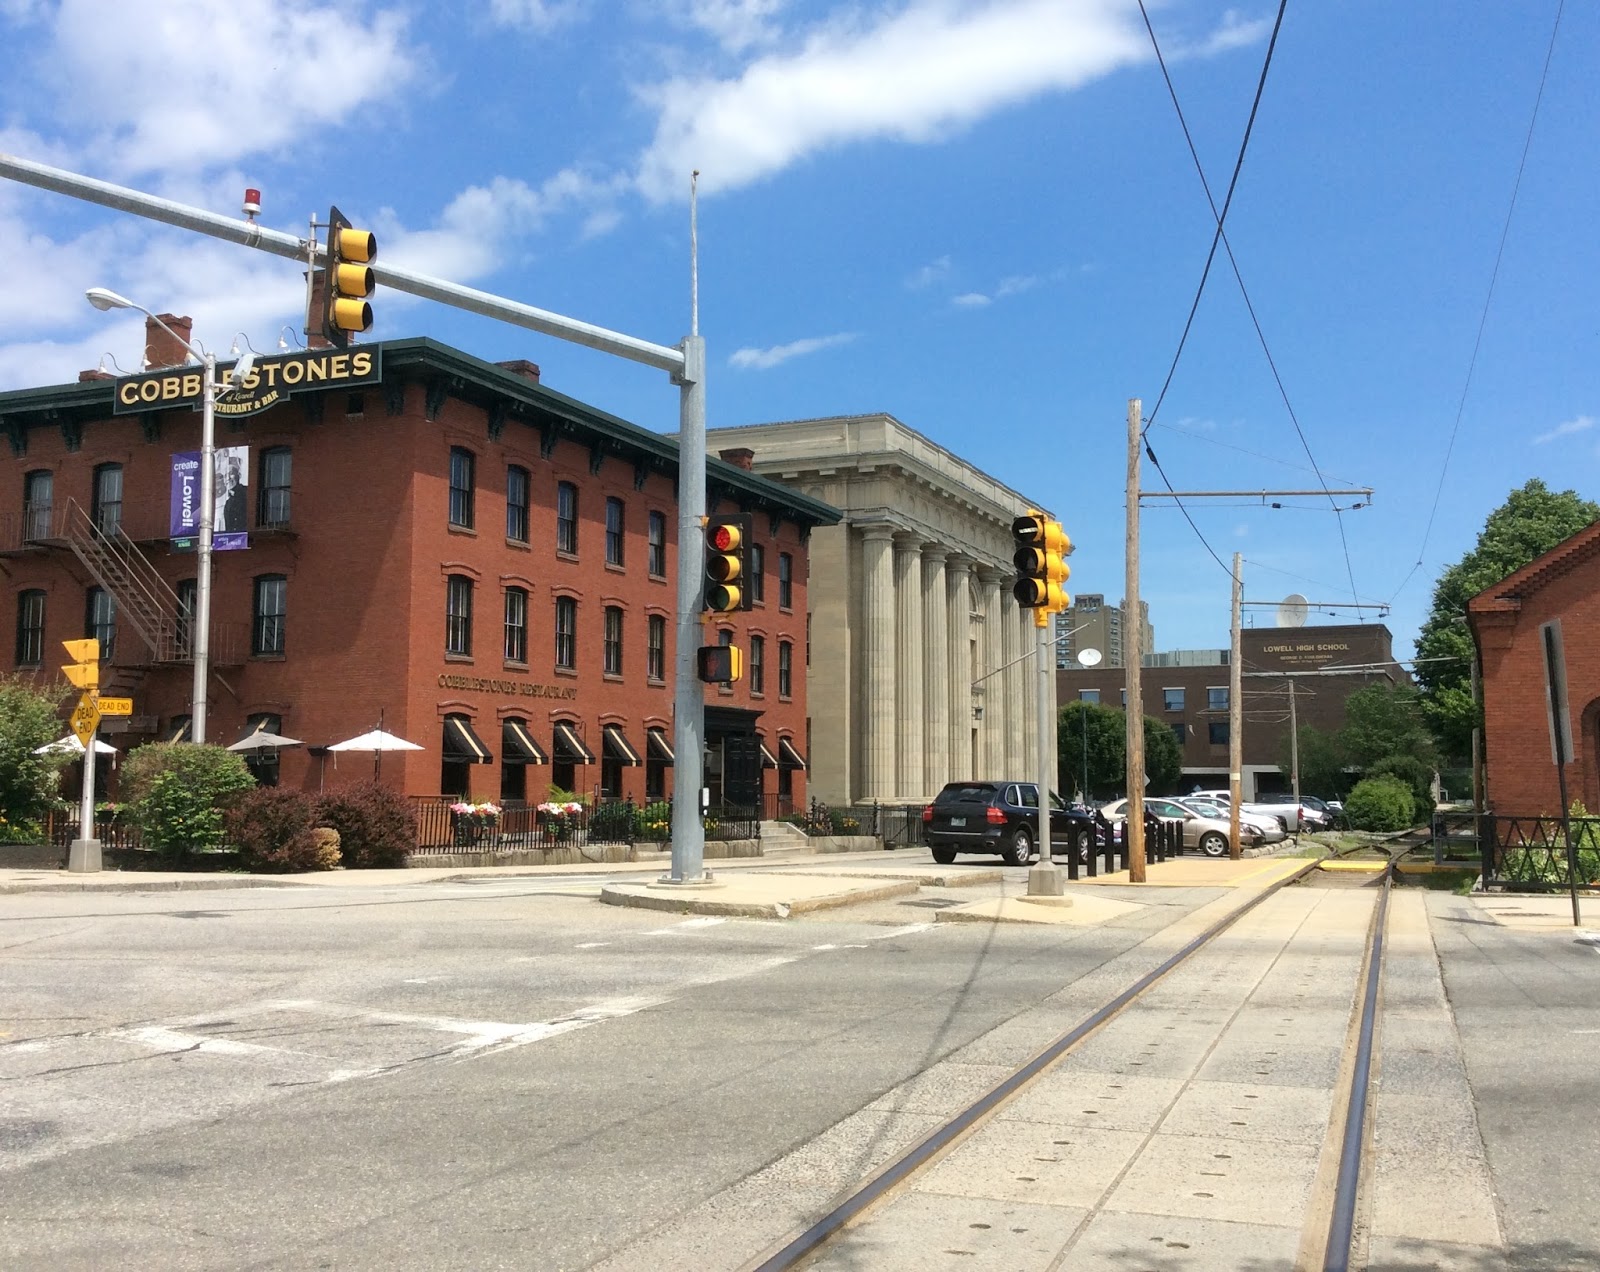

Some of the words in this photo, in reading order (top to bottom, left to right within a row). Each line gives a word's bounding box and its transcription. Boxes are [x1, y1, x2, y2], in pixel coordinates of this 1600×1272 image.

[214, 402, 252, 413] STAURANT
[254, 401, 261, 409] &
[261, 390, 279, 406] BAR
[234, 391, 255, 401] Lowell
[174, 460, 199, 471] create
[182, 476, 194, 527] Lowell
[1263, 645, 1293, 653] LOWELL
[1296, 644, 1315, 652] HIGH
[1317, 643, 1350, 651] SCHOOL
[438, 674, 517, 694] COBBLESTONES
[519, 682, 577, 700] RESTAURANT
[99, 702, 115, 711] DEAD
[117, 703, 129, 711] END
[77, 707, 93, 720] DEAD
[79, 721, 92, 734] END
